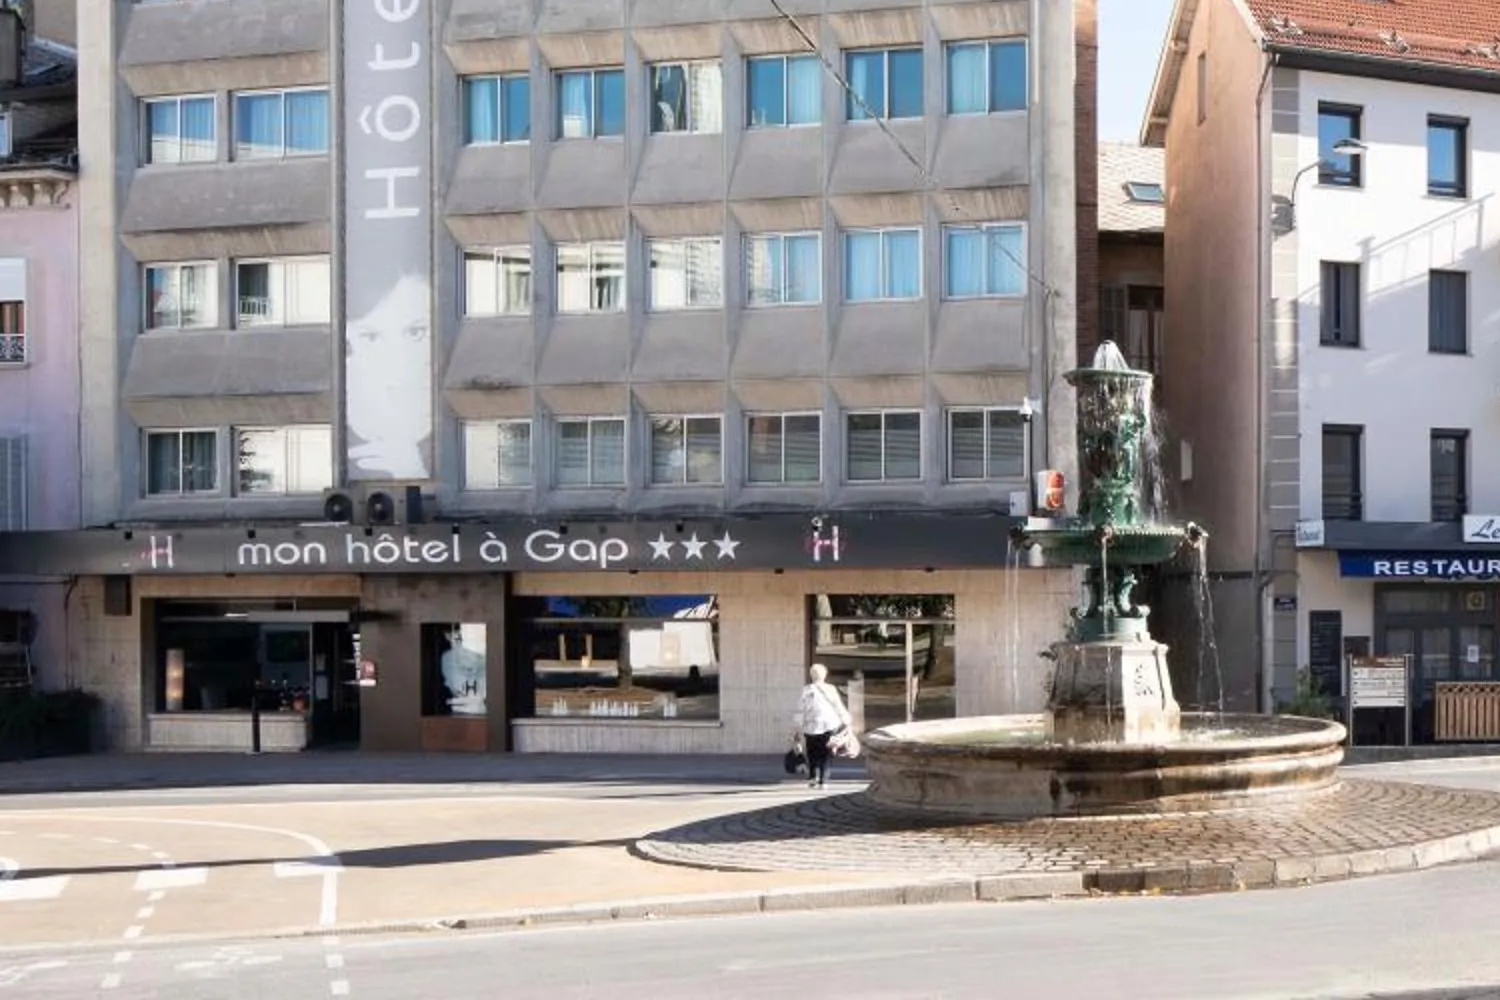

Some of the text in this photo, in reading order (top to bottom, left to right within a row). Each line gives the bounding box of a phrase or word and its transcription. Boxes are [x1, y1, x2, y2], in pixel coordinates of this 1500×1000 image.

[237, 529, 629, 569] mon hôtel à Gap
